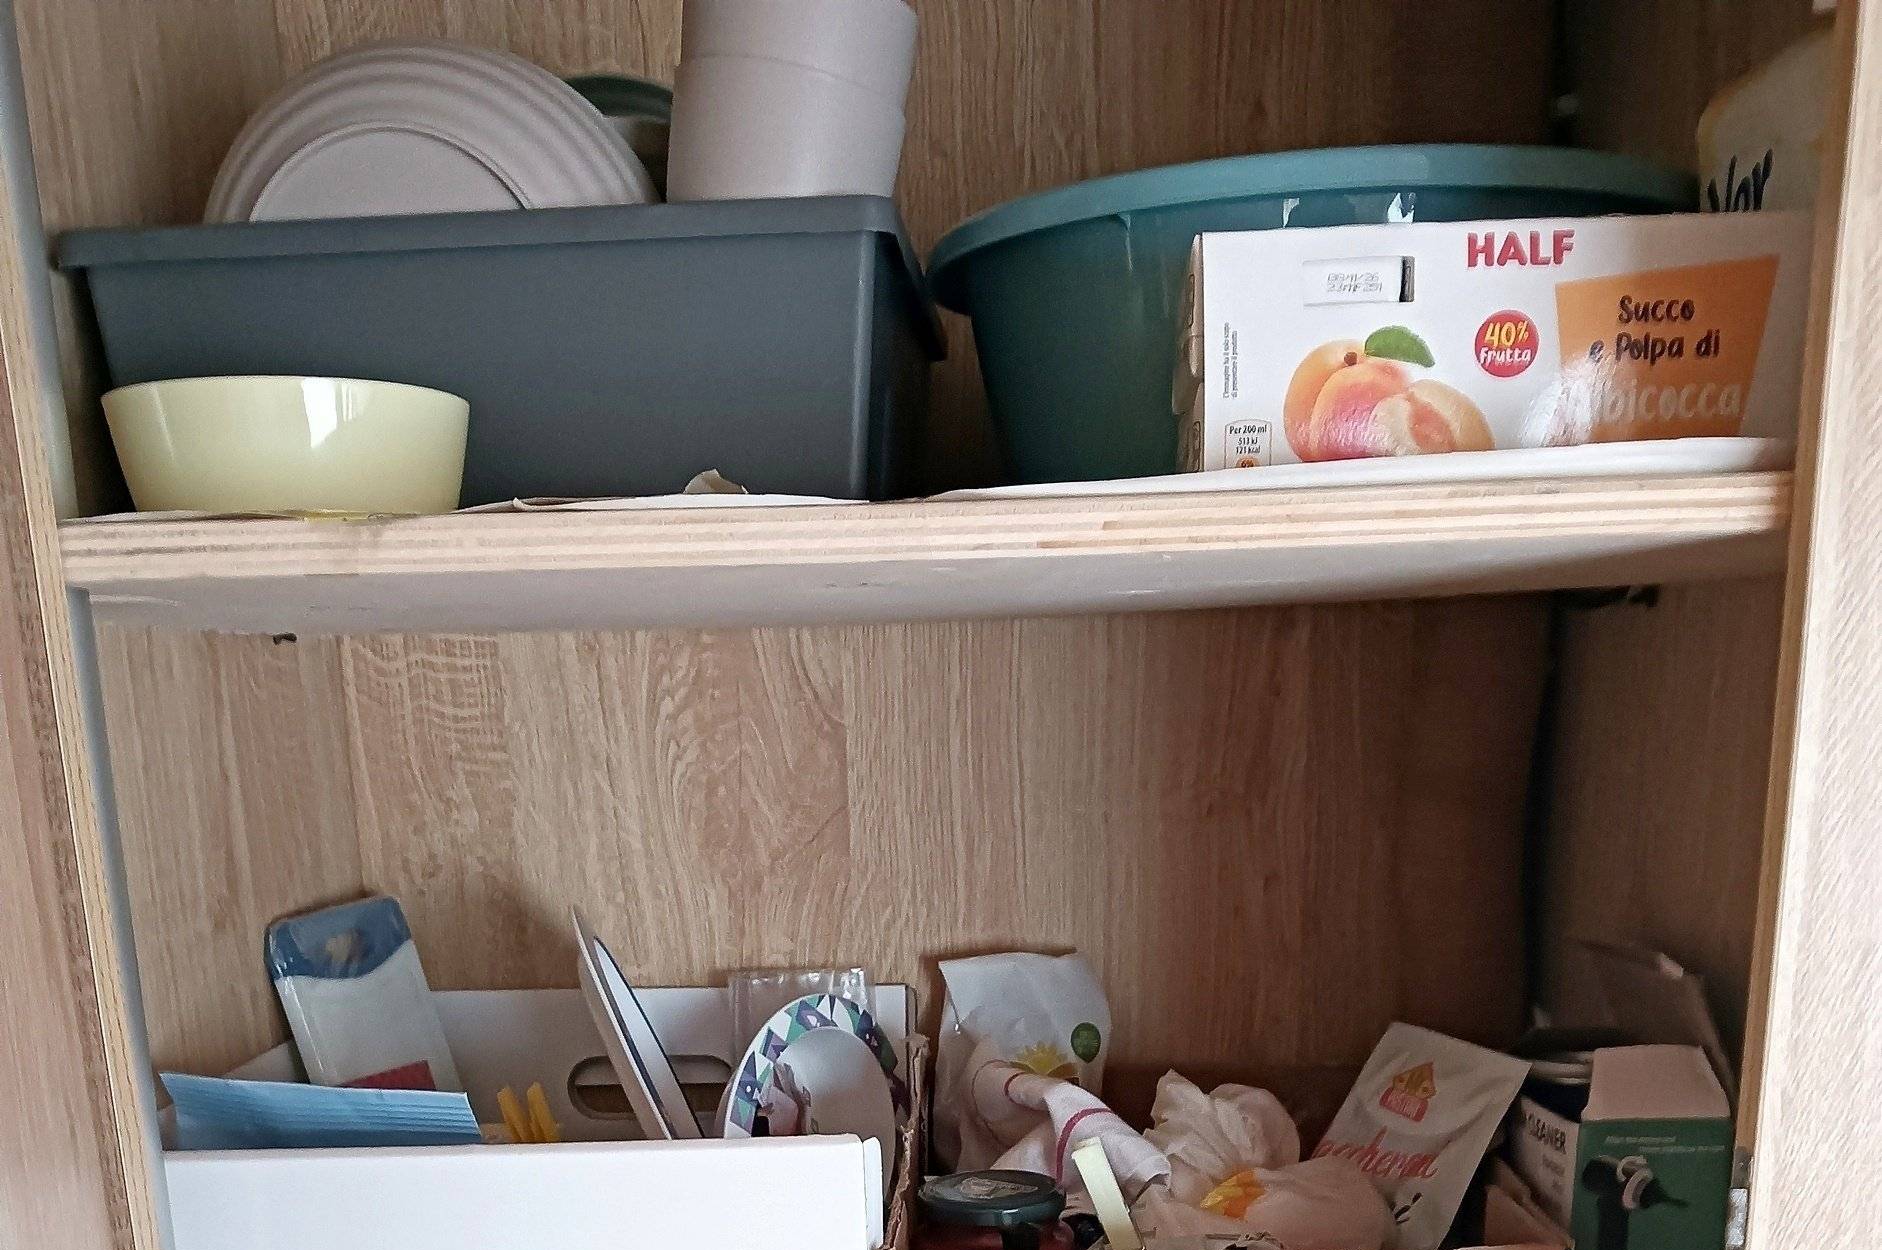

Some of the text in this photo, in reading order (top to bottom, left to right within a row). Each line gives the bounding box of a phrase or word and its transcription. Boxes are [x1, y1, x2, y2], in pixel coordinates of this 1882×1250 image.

[1467, 229, 1575, 268] HALF
[1617, 294, 1695, 324] Succo
[1485, 321, 1529, 348] 40%
[1589, 328, 1721, 366] e Polpa di
[1479, 346, 1532, 370] frutta
[1229, 424, 1267, 435] Per 200 ml
